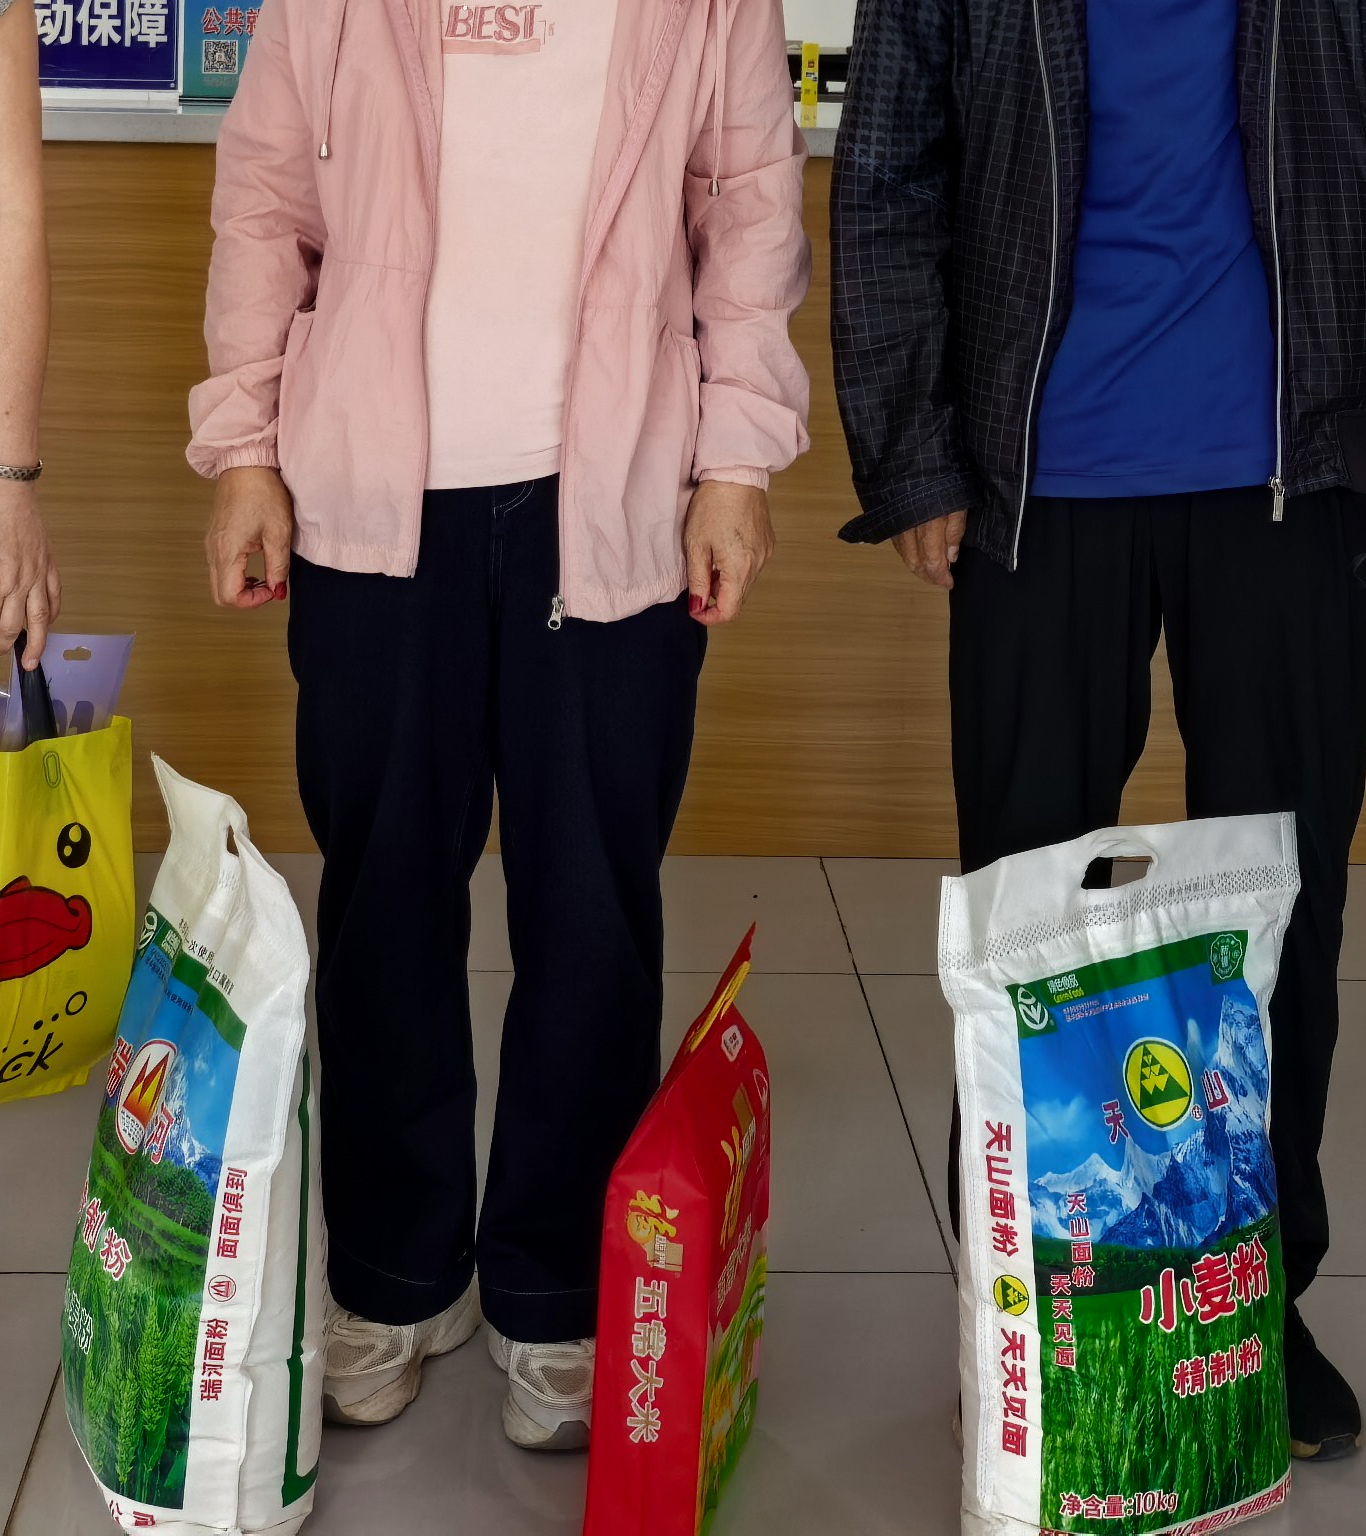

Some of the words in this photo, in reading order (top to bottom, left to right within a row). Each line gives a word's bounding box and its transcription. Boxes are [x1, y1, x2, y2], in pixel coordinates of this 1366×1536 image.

[445, 5, 542, 42] BEST
[1102, 1100, 1130, 1144] 天
[1205, 1069, 1228, 1110] 山
[983, 1120, 1019, 1258] 天山面粉
[200, 1318, 229, 1401] 瑞河面粉
[217, 1167, 249, 1258] 面面俱到
[1067, 1193, 1095, 1288] 天山面粉
[1140, 1235, 1270, 1333] 小麦粉
[626, 1277, 668, 1443] 五常大米
[1050, 1274, 1075, 1368] 天天见面
[1173, 1334, 1263, 1397] 精制粉
[1000, 1327, 1027, 1458] 天天见面
[1060, 1492, 1178, 1519] 净含量:10kg
